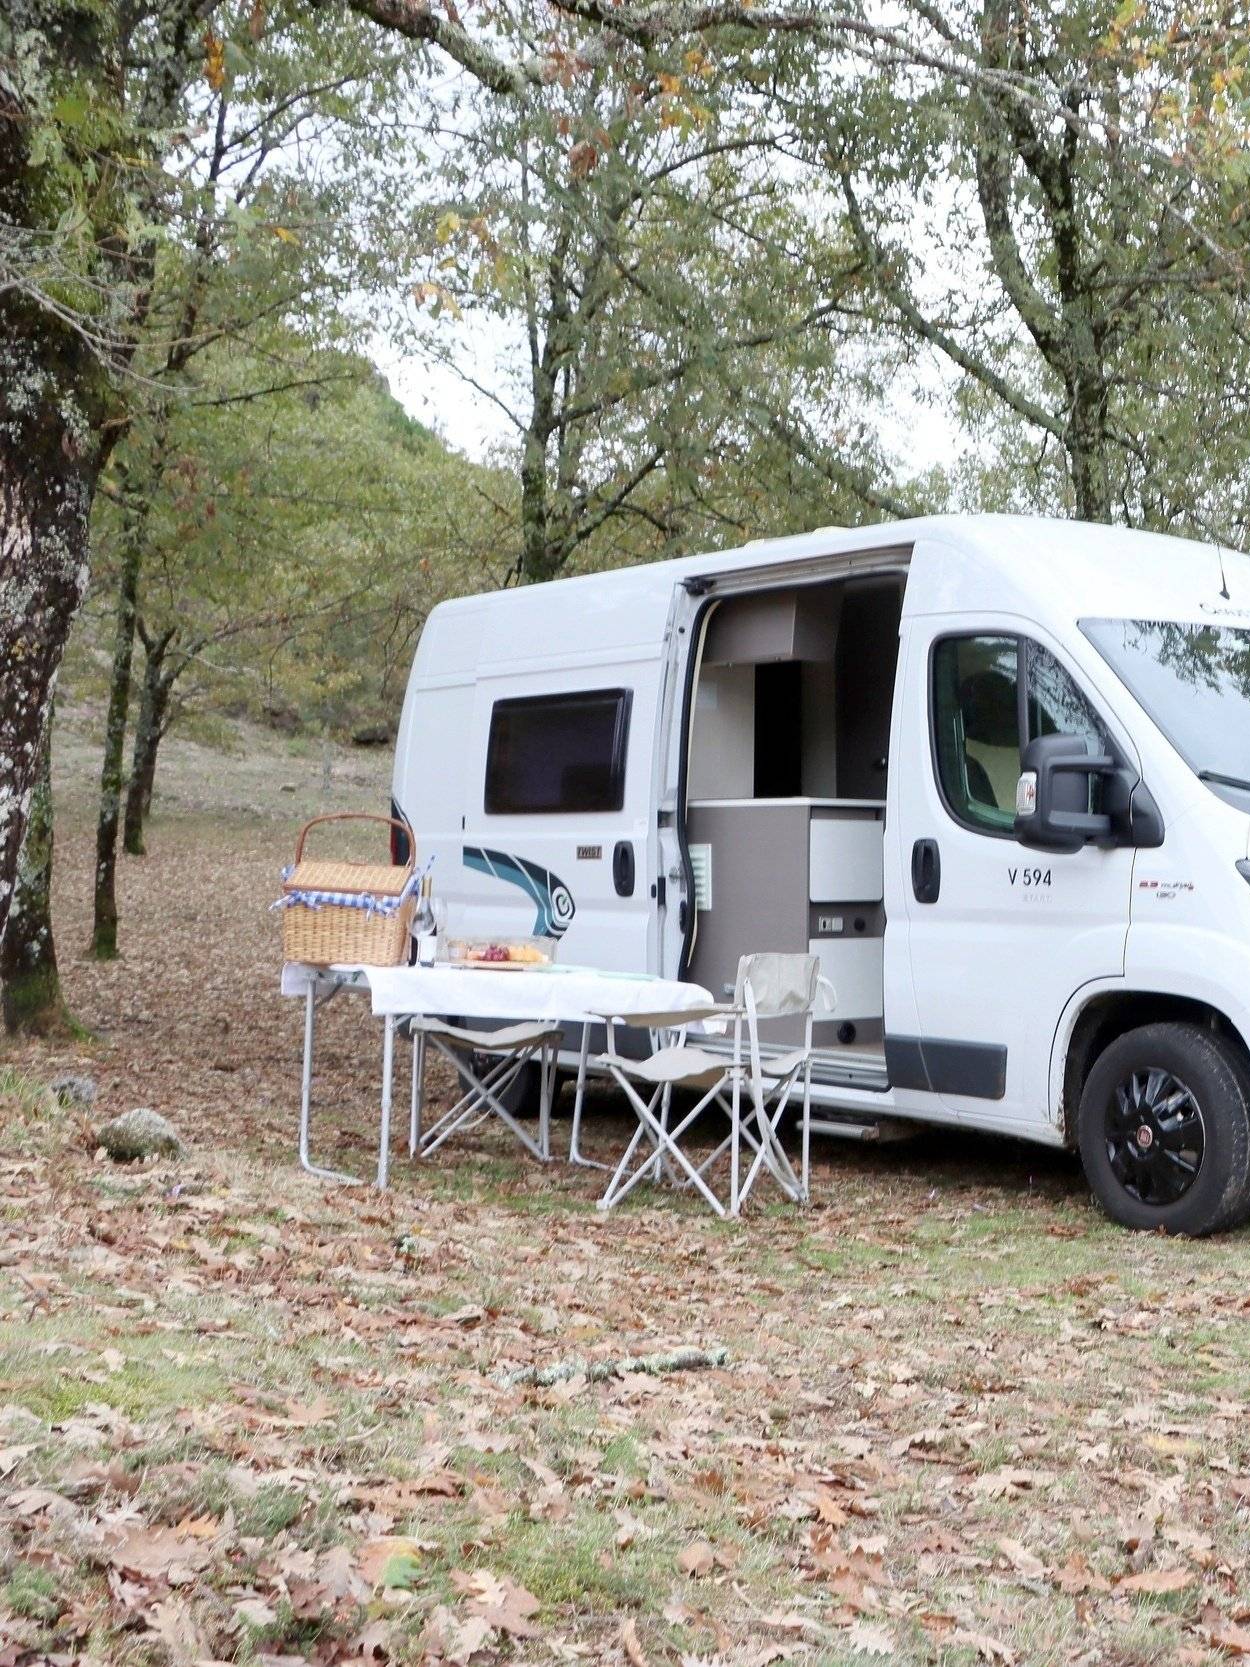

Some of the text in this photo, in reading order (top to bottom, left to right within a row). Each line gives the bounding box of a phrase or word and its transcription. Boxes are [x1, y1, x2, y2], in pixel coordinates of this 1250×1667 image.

[577, 846, 602, 858] TWIST
[1008, 868, 1051, 886] V 594
